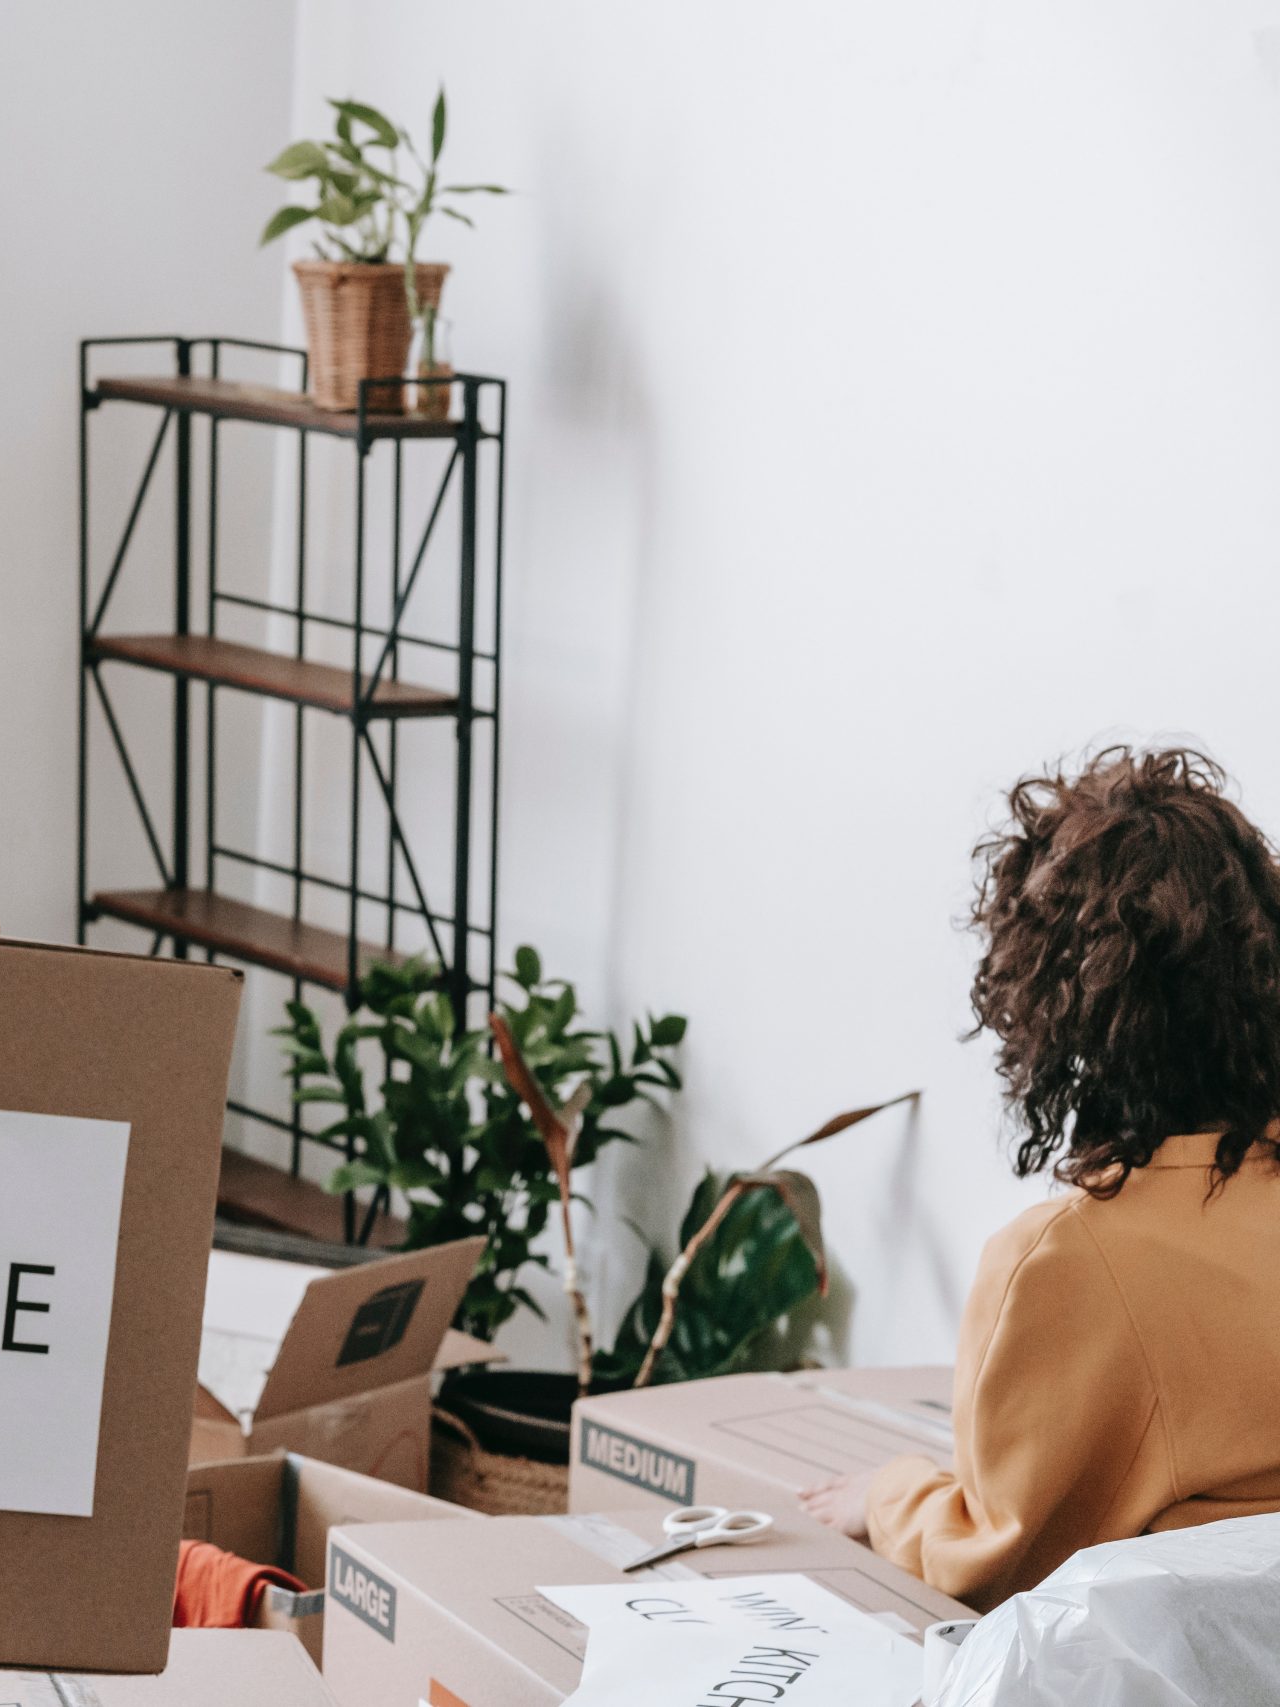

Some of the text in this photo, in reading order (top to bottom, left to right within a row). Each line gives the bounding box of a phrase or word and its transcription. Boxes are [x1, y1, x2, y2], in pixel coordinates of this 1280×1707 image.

[587, 1427, 687, 1497] MEDIUM
[335, 1556, 390, 1628] LARGE
[719, 1592, 828, 1633] WIN
